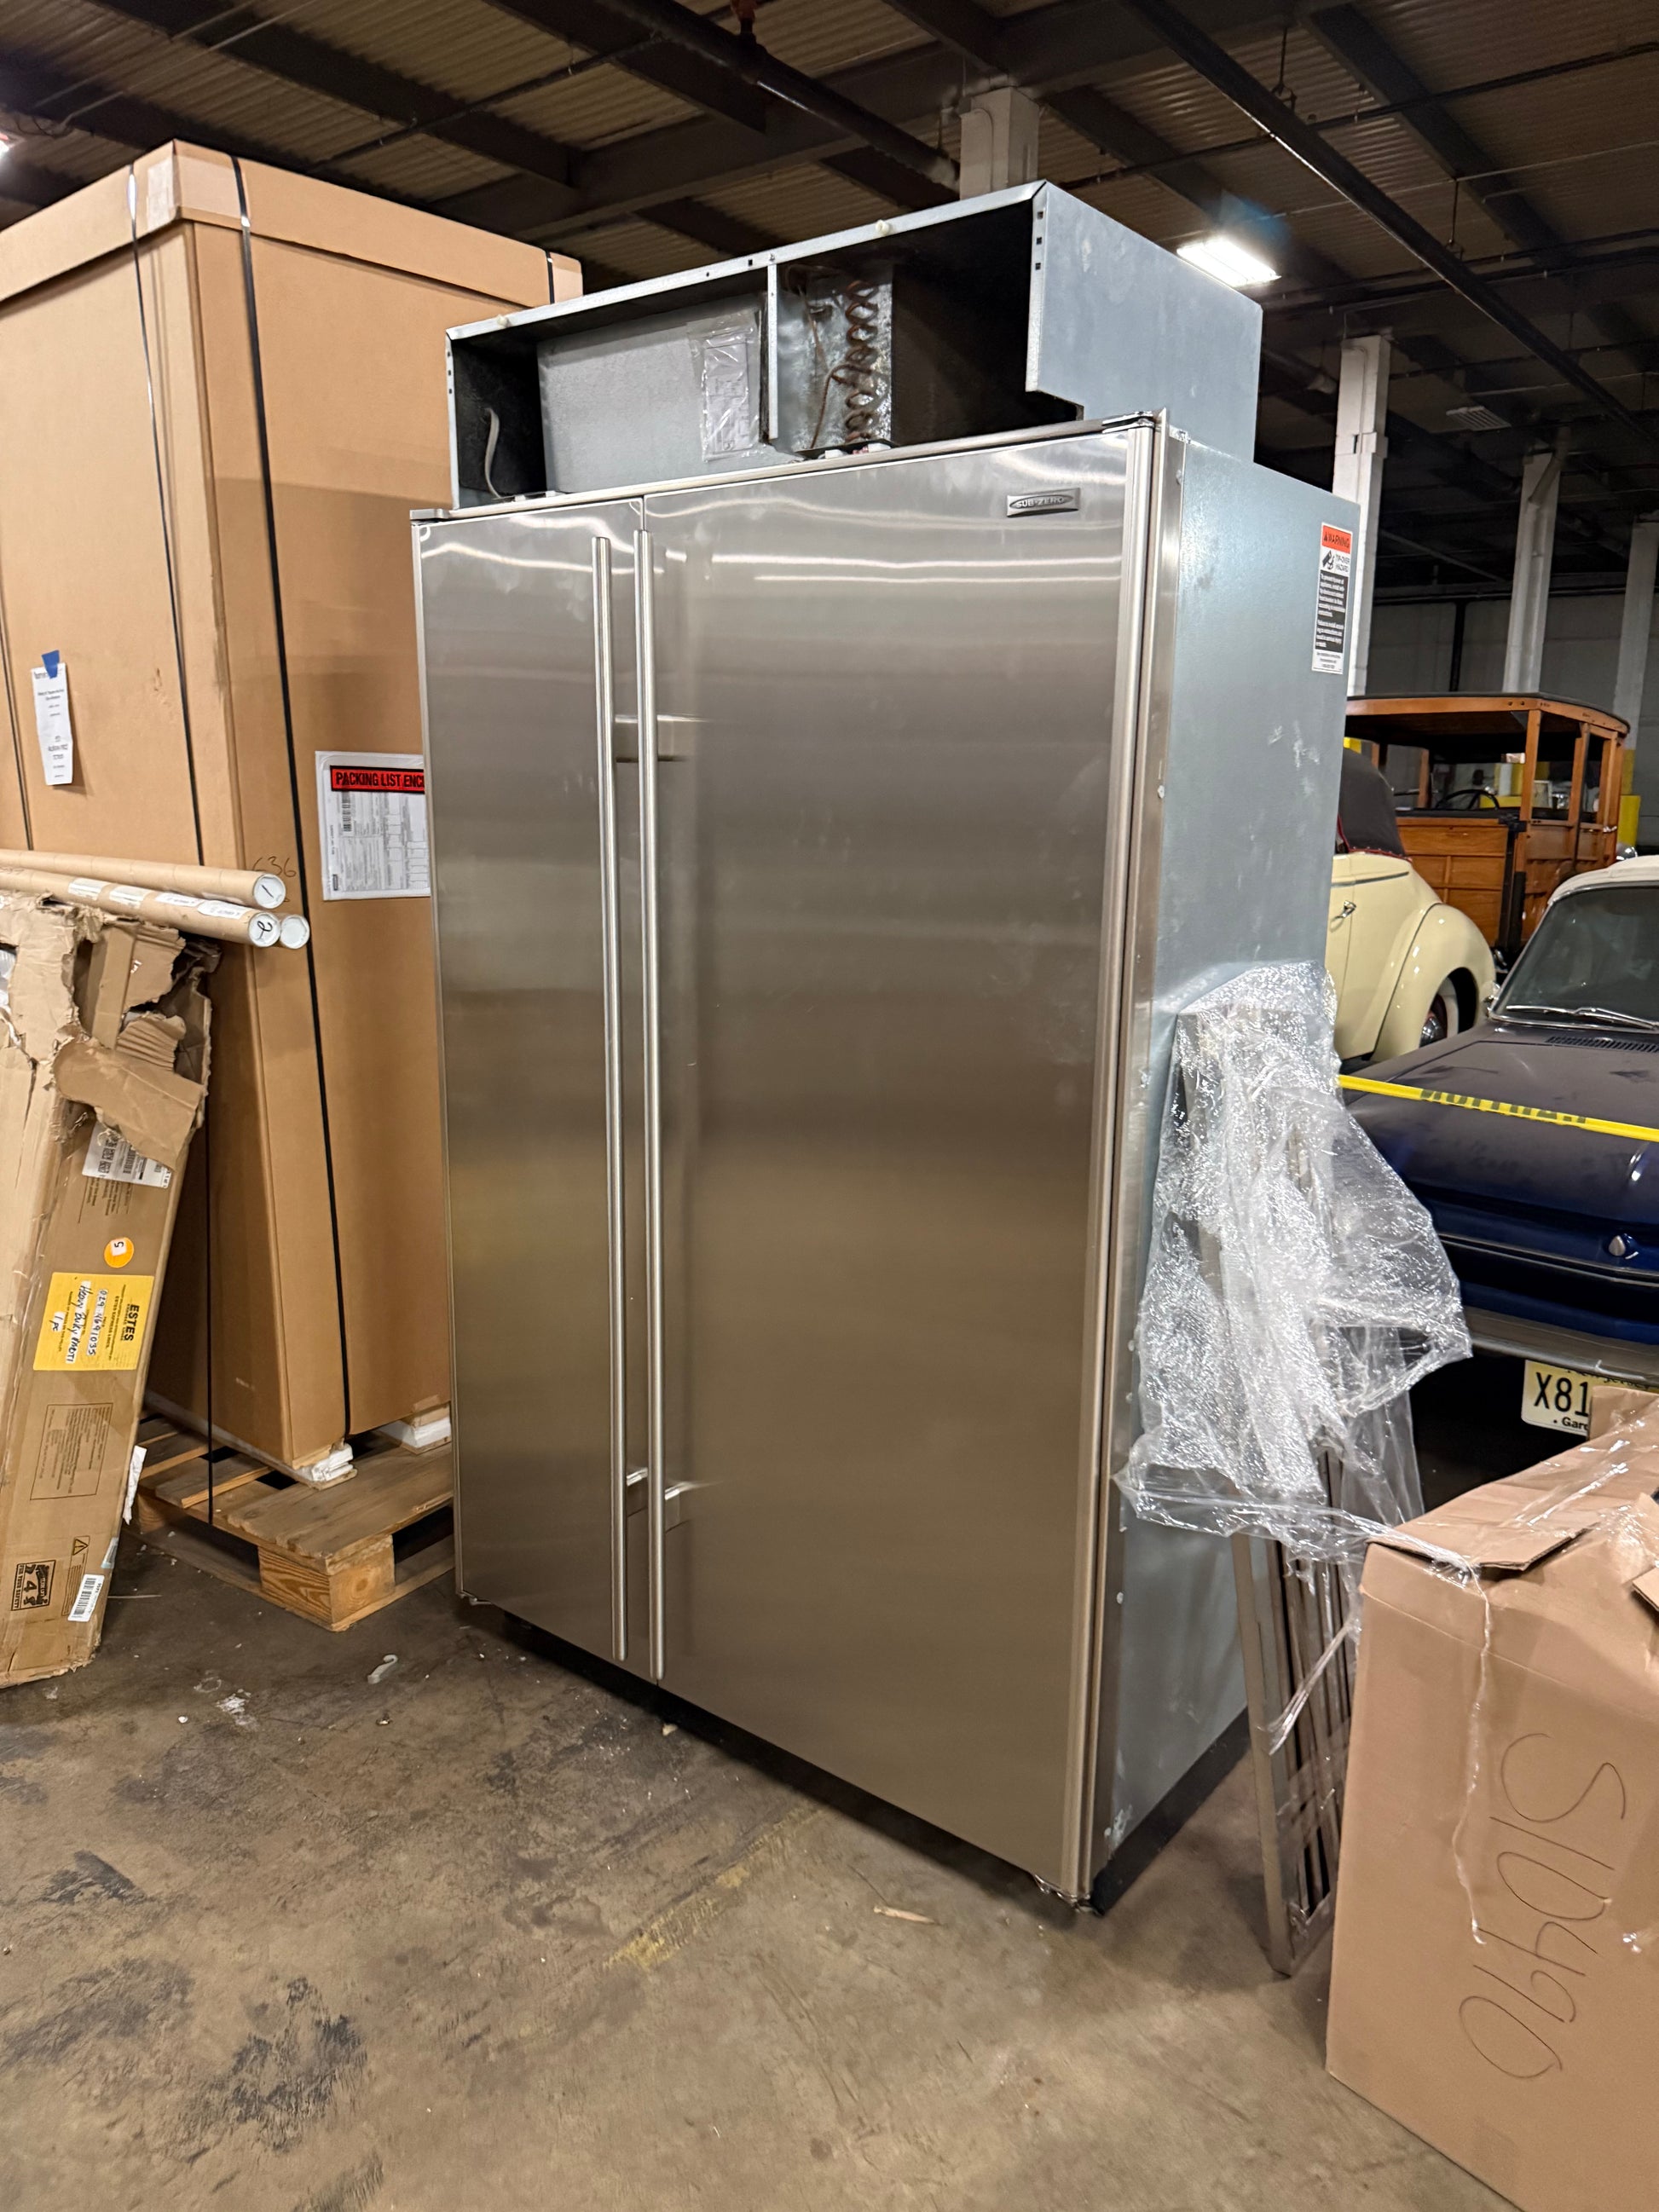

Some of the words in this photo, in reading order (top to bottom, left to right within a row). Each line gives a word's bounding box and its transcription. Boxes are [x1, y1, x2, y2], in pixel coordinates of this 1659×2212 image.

[1327, 532, 1350, 548] WARNING
[335, 771, 379, 786] PACKING
[380, 774, 402, 787] LIST
[123, 1304, 140, 1341] ESTES
[1534, 1372, 1589, 1417] X81
[24, 1580, 38, 1592] 4
